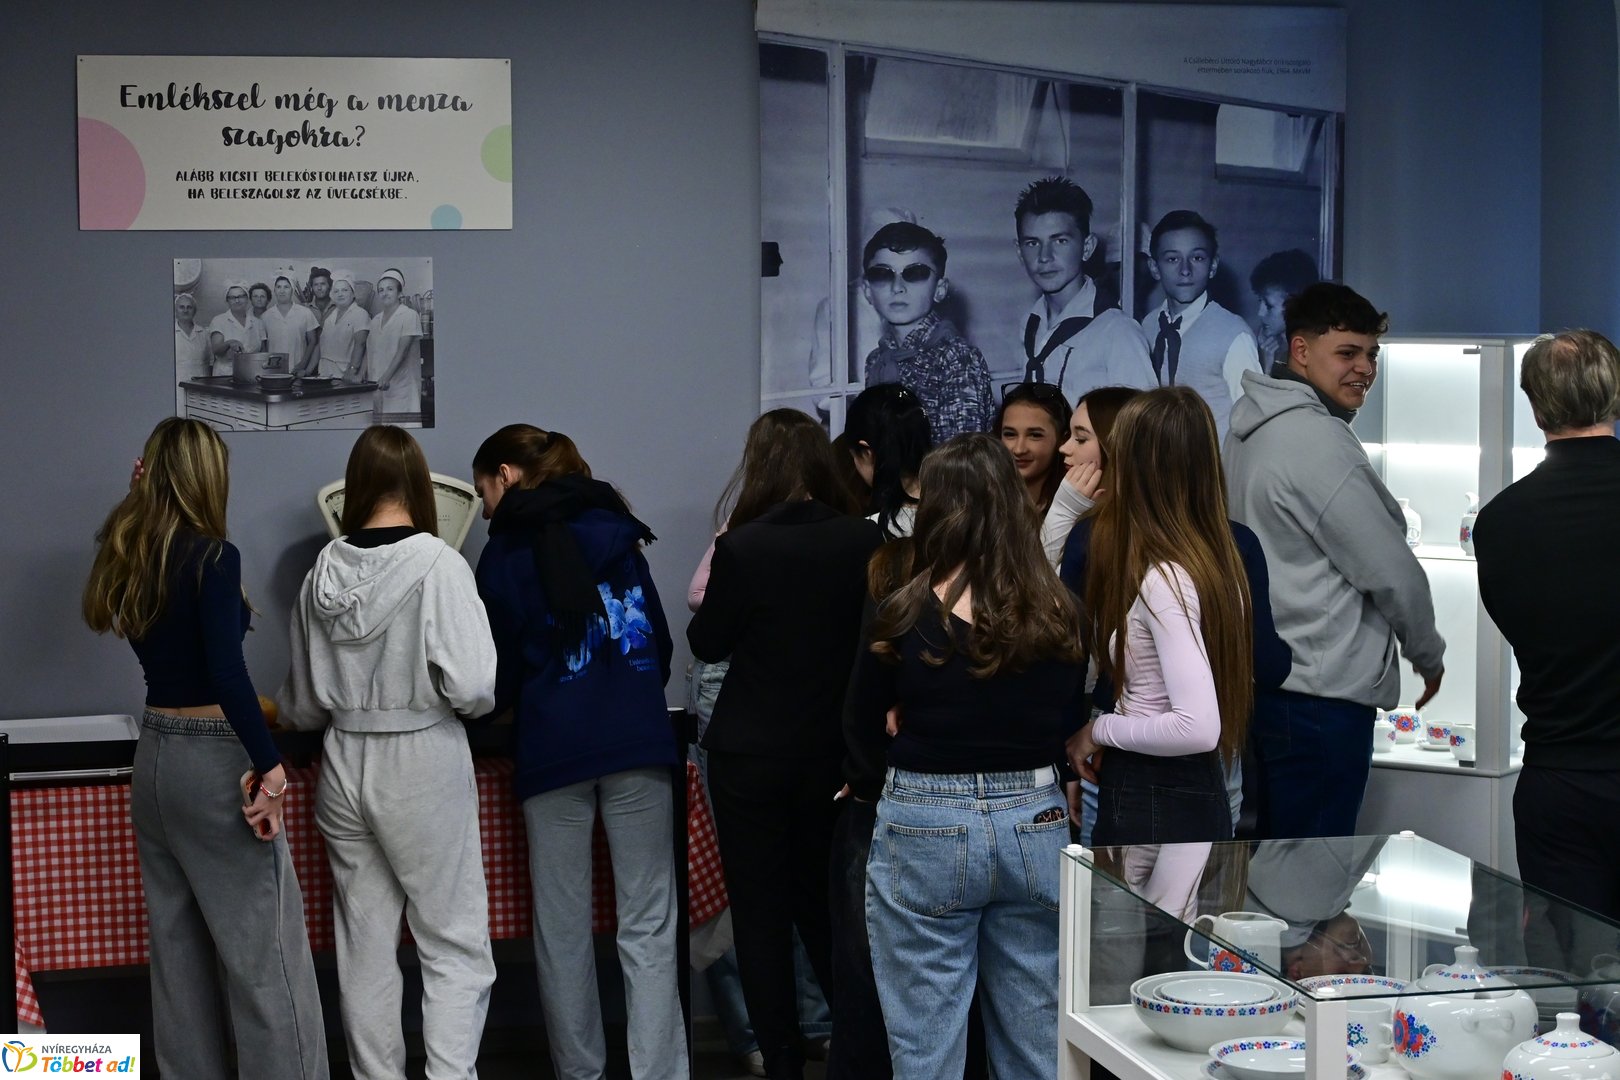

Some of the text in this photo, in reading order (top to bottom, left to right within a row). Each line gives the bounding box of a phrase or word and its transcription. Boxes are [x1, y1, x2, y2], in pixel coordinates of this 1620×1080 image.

[120, 82, 472, 118] Emlékszel még a menza
[222, 120, 365, 154] szagokra?
[176, 169, 214, 182] ALÁBB
[219, 170, 259, 182] KICSIT
[265, 169, 377, 182] BELEKÓSTOLHATSZ
[187, 188, 205, 199] HA
[211, 188, 300, 199] BELESZAGOLSZ
[306, 188, 321, 199] AZ
